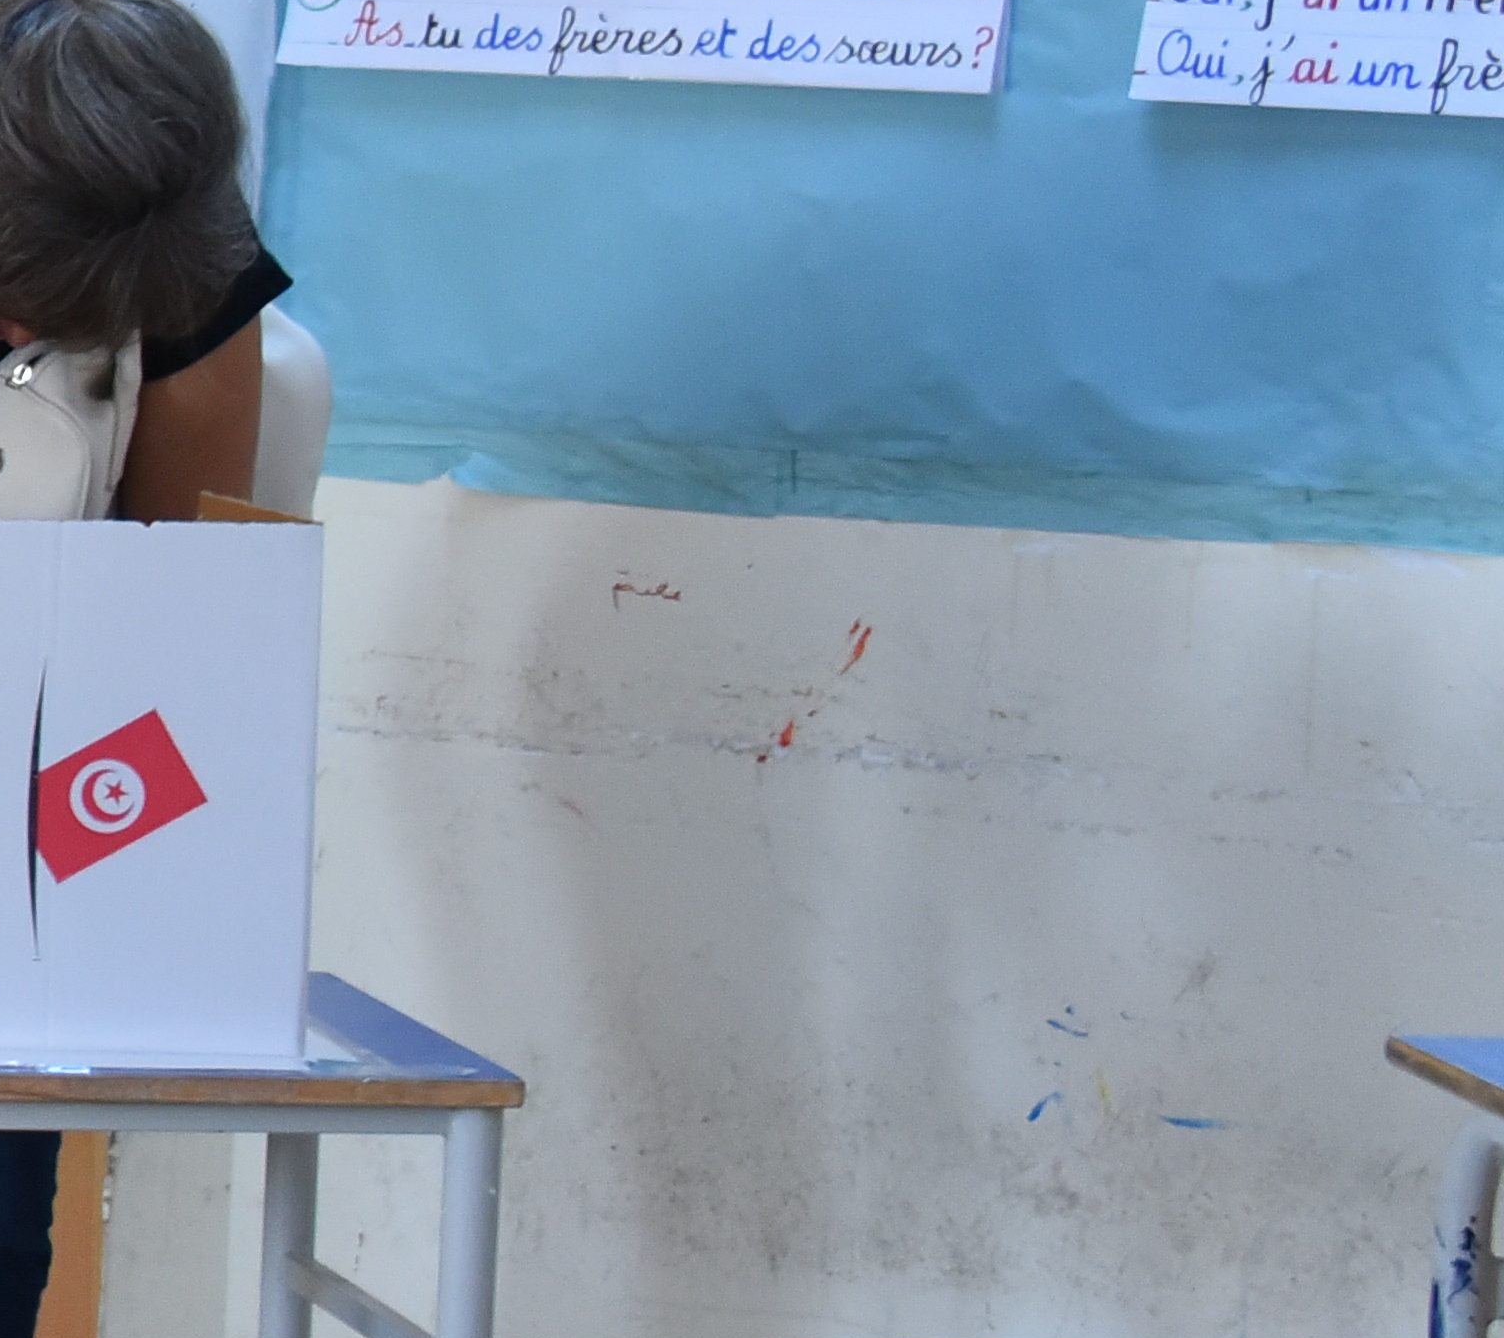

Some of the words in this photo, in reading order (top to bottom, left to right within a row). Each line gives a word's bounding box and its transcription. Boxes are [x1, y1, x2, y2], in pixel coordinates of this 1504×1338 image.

[473, 13, 543, 51] des
[549, 6, 683, 75] frères
[690, 18, 737, 58] et
[746, 19, 820, 63] des
[1348, 60, 1422, 91] un
